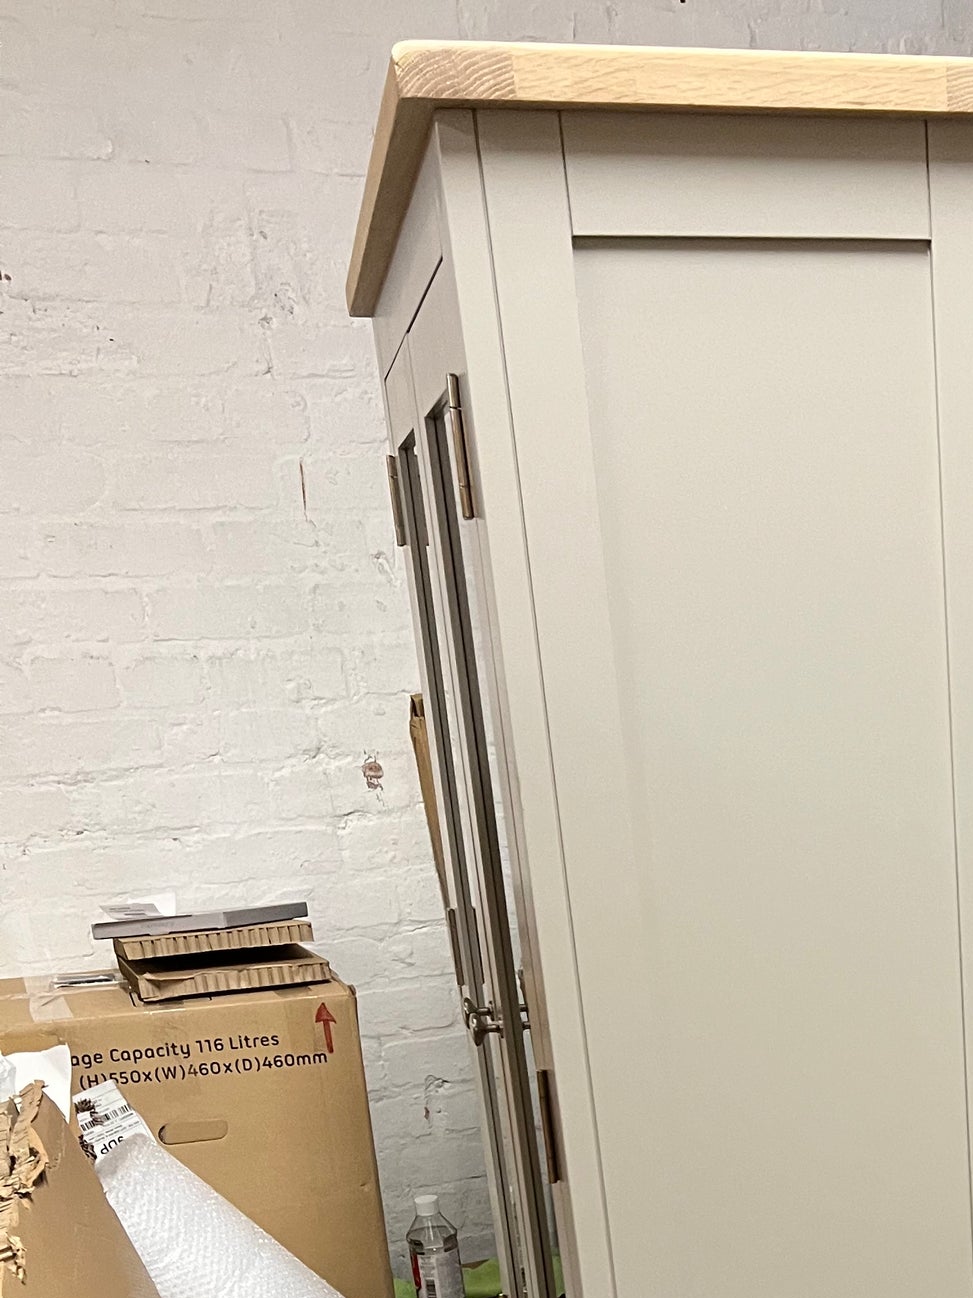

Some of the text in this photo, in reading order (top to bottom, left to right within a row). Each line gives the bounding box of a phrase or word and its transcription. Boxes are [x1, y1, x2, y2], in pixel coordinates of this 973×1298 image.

[109, 1043, 190, 1064] Capacity
[195, 1038, 224, 1053] 116
[228, 1034, 279, 1050] Litres
